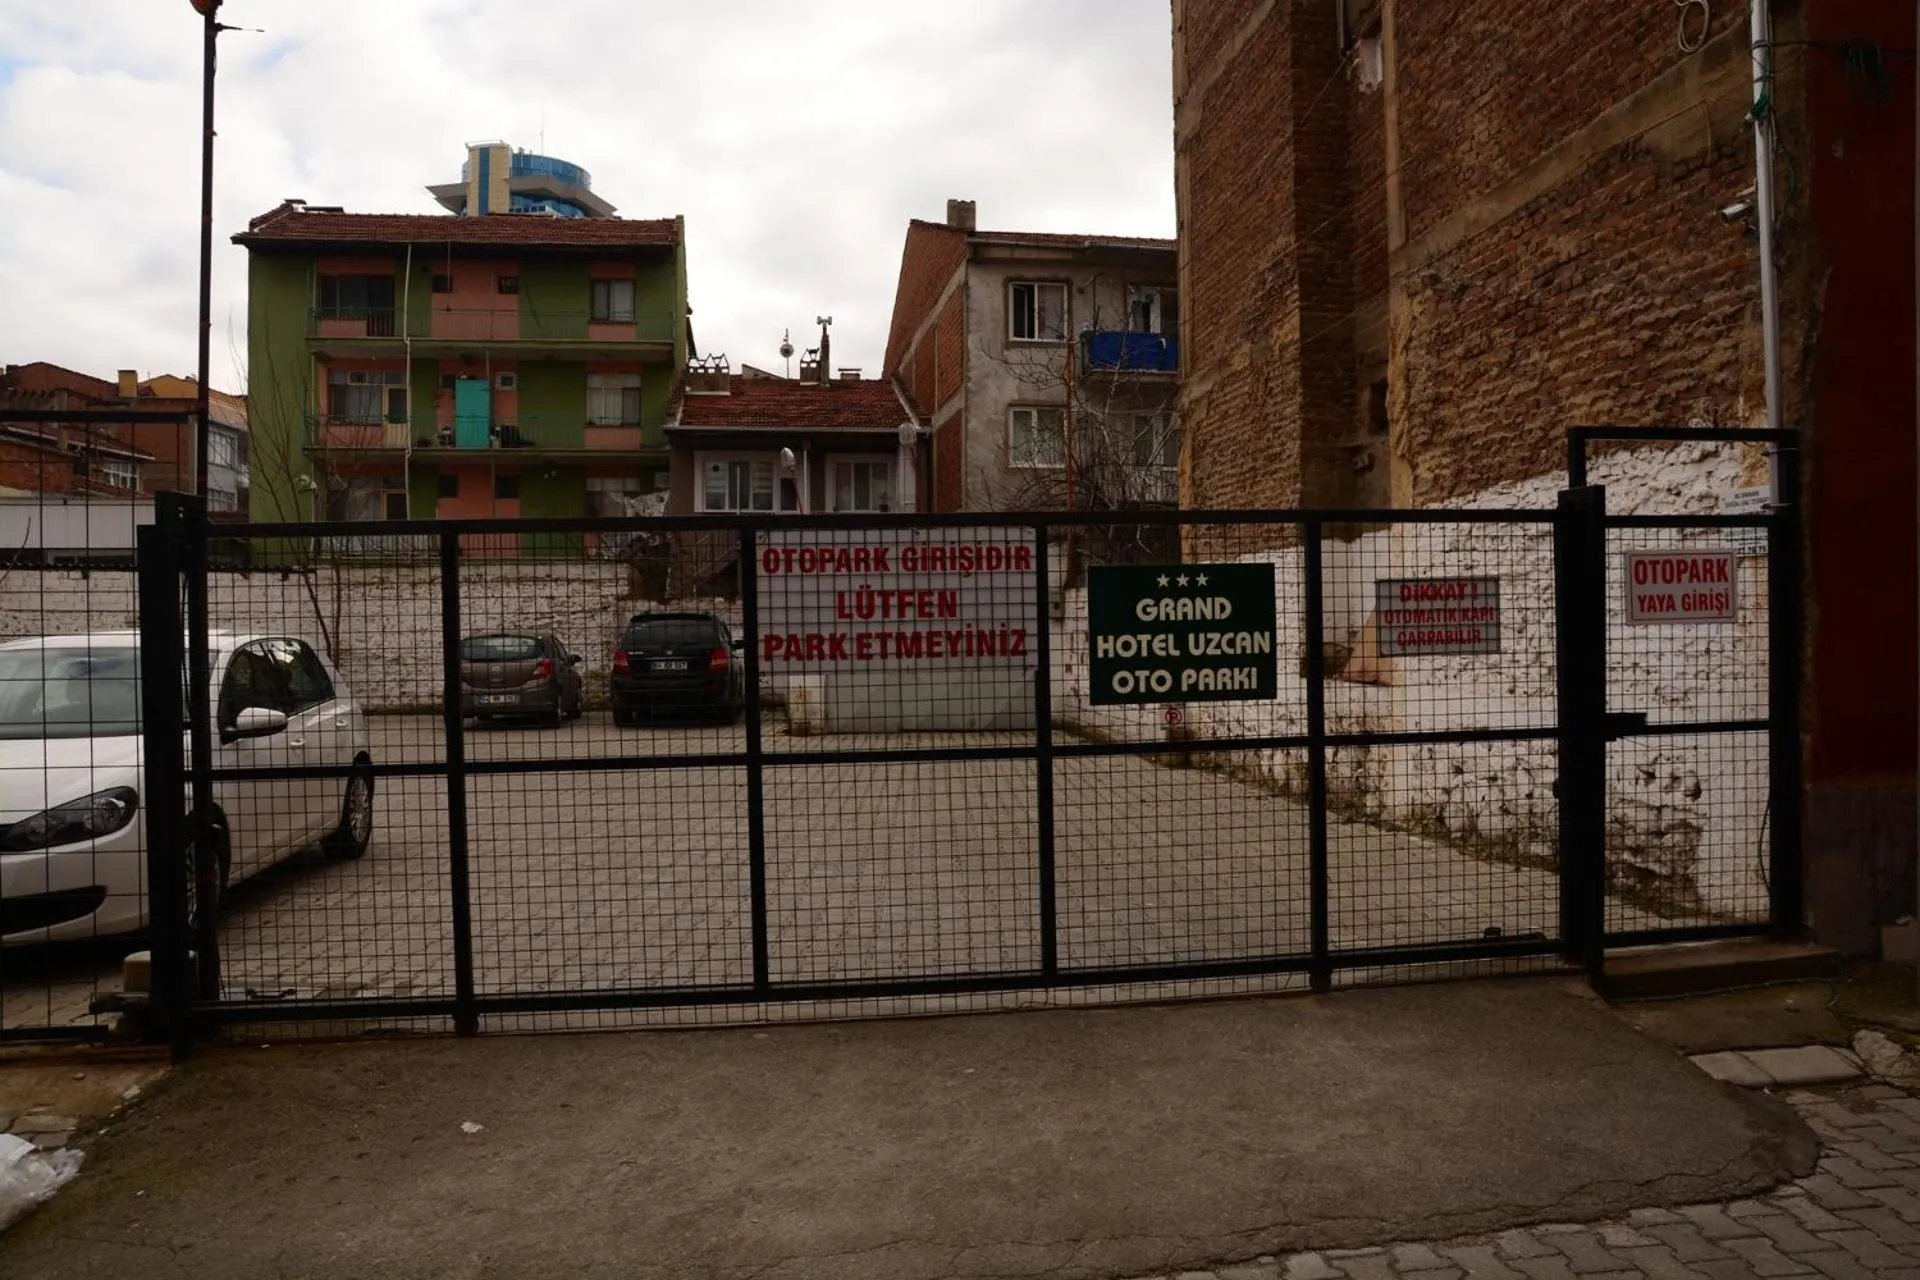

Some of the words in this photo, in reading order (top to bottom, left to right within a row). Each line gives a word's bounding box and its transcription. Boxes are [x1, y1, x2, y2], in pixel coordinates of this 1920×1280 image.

[762, 547, 890, 573] OTOPARK
[901, 541, 1032, 577] GİRİŞİDİR
[1634, 558, 1729, 585] OTOPARK
[837, 584, 957, 620] LÜTFEN
[1136, 597, 1232, 621] GRAND
[1638, 593, 1676, 612] YAYA
[1681, 588, 1729, 615] GİRİŞİ
[763, 633, 849, 662] PARK
[856, 623, 1026, 661] ETMEYİNİZ
[1097, 633, 1180, 658] HOTEL
[1188, 631, 1270, 656] UZCAN
[1112, 669, 1173, 694] OTO
[1181, 667, 1257, 692] PARKI
